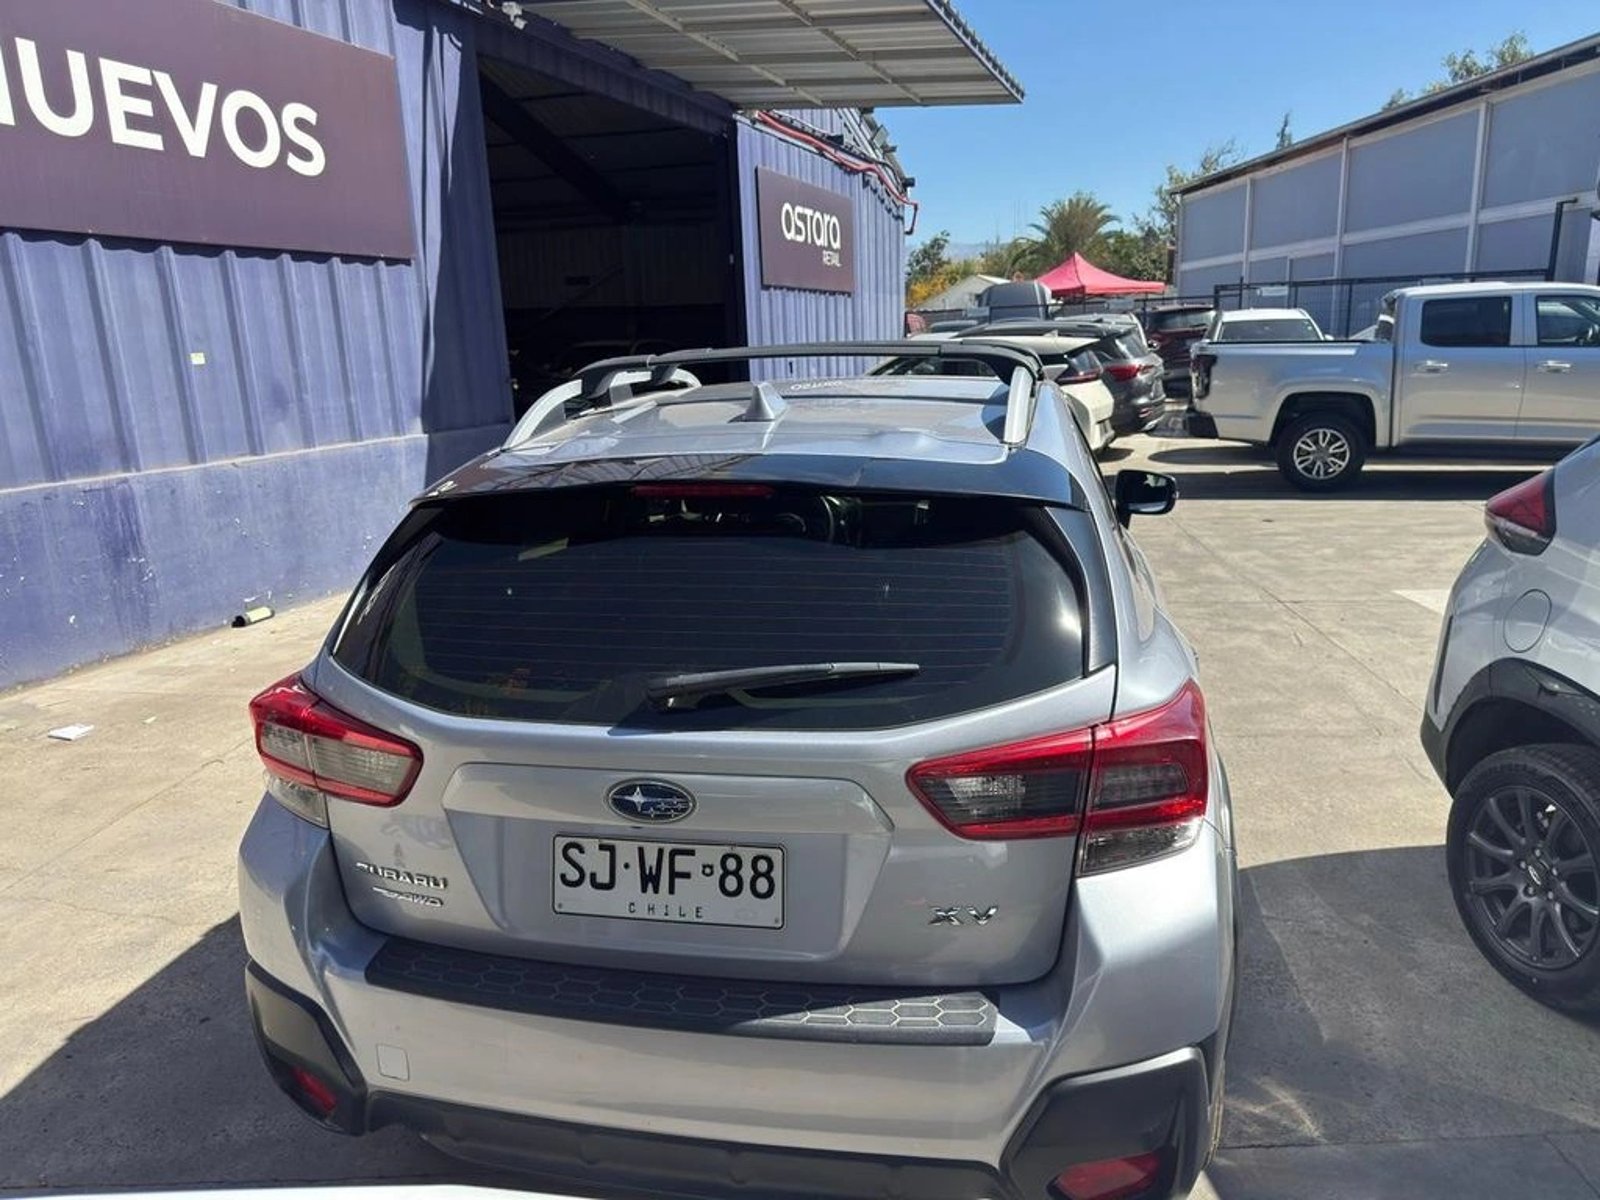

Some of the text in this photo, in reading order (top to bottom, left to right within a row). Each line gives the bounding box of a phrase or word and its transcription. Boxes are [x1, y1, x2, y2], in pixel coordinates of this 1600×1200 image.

[781, 202, 841, 250] astara
[628, 902, 704, 919] CHILE
[928, 905, 998, 926] XV
